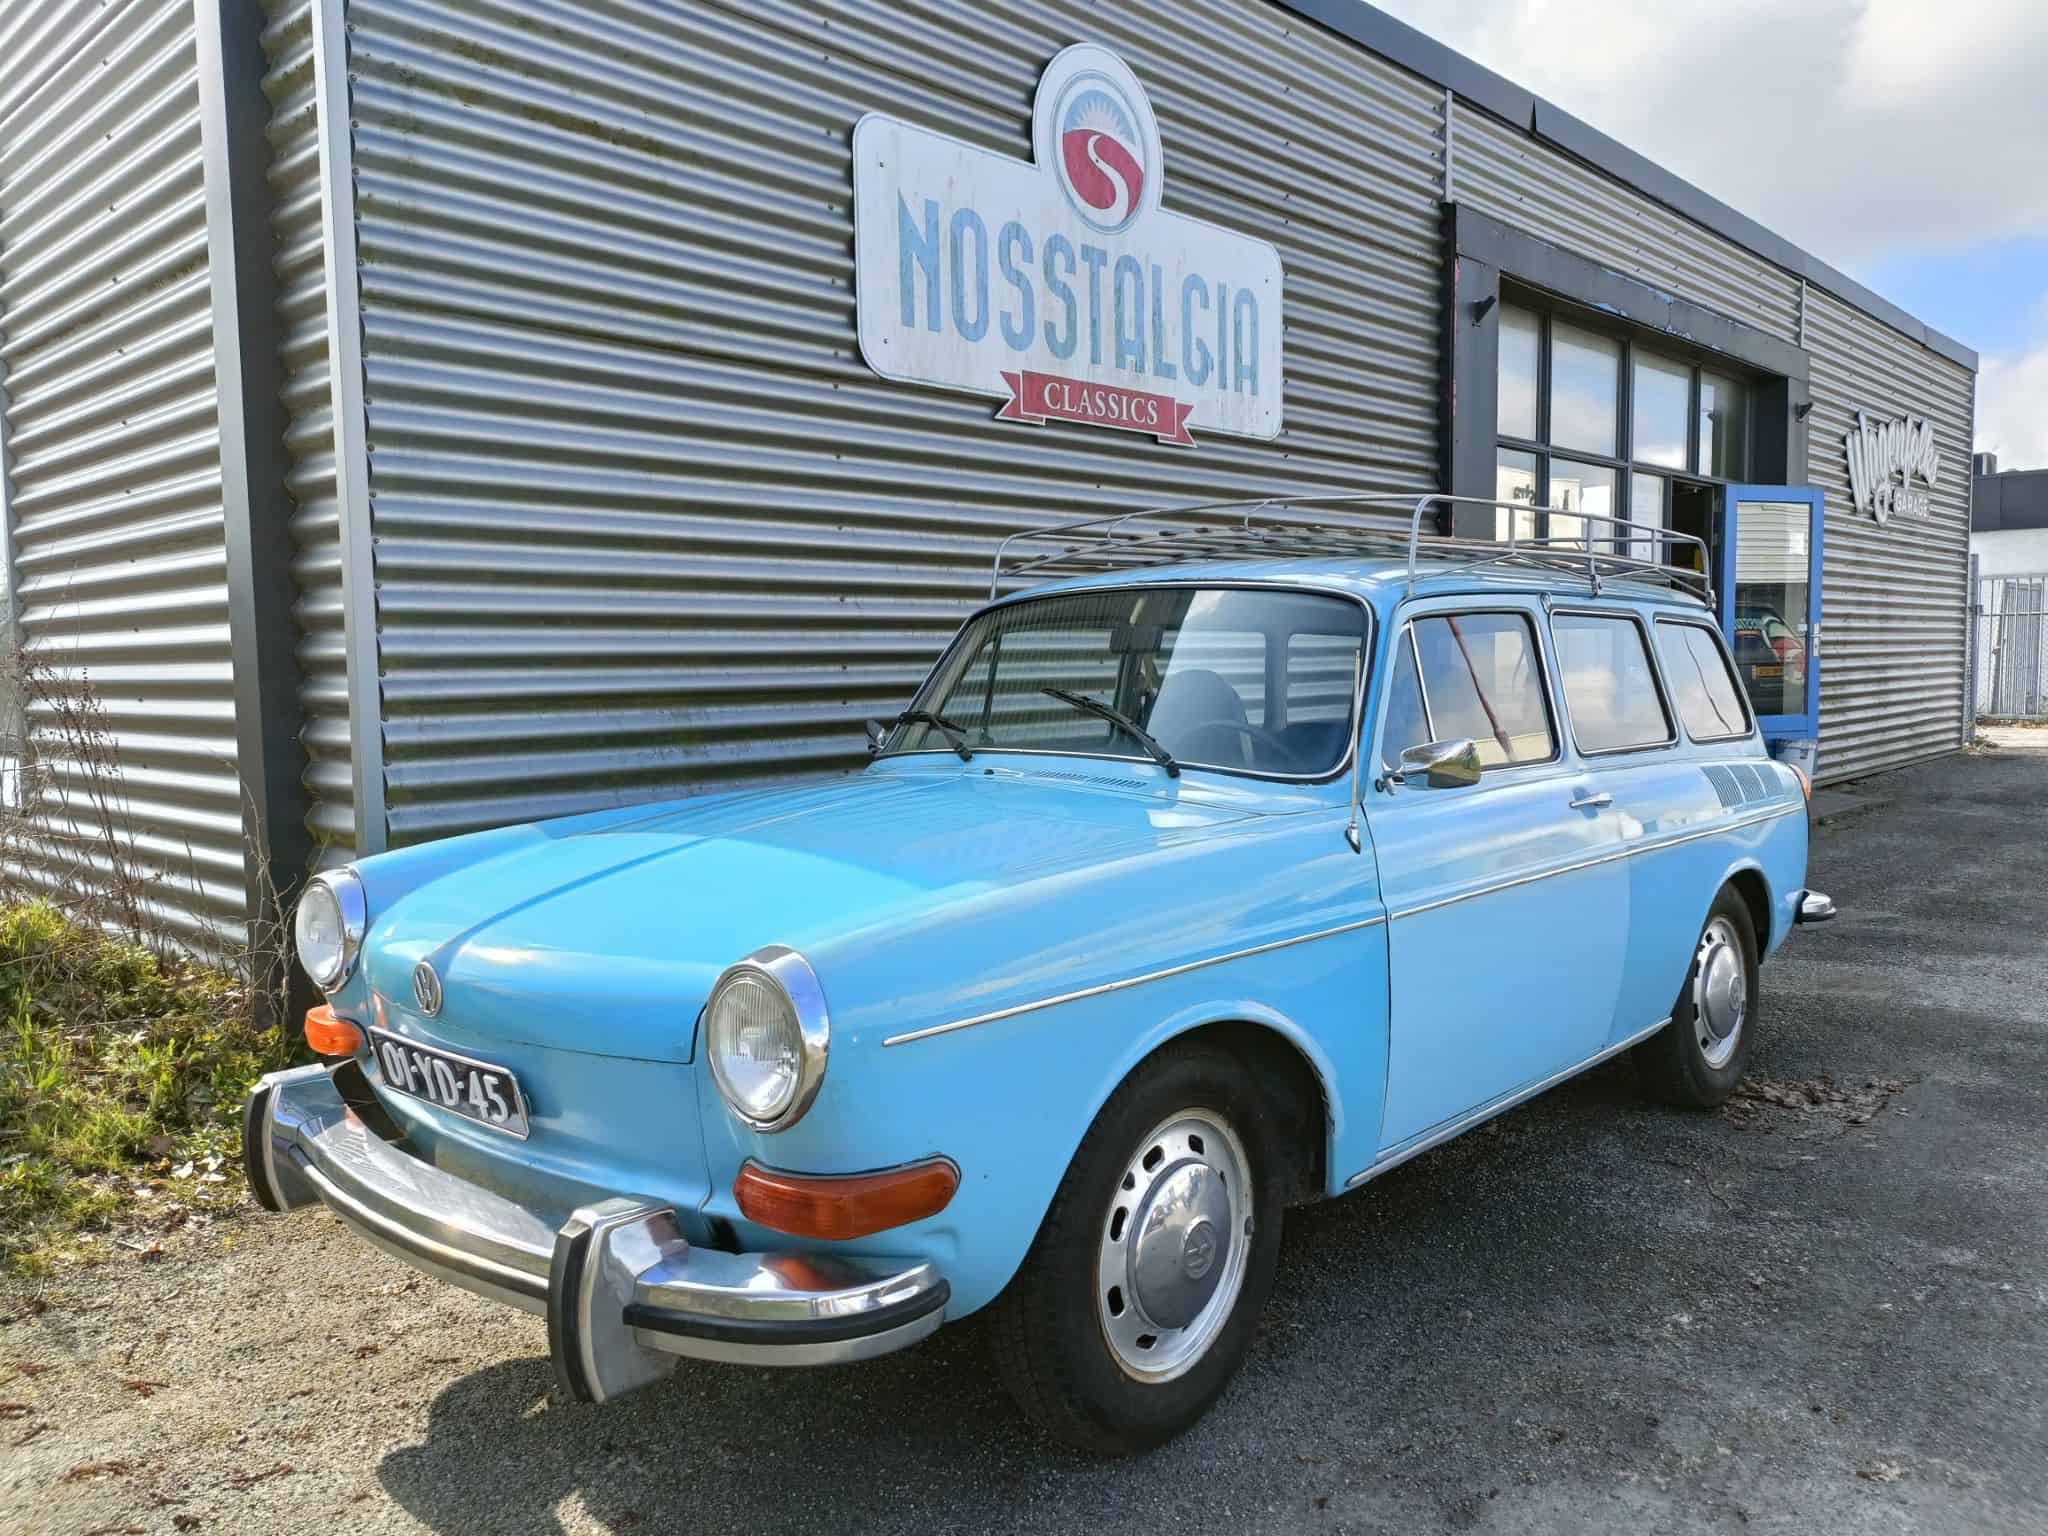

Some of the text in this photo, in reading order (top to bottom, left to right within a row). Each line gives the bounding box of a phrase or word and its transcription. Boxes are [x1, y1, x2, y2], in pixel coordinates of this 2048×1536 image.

[899, 189, 1259, 396] NOSSTALGIA
[1044, 382, 1158, 425] CLASSICS
[1896, 493, 1929, 519] GARAGE
